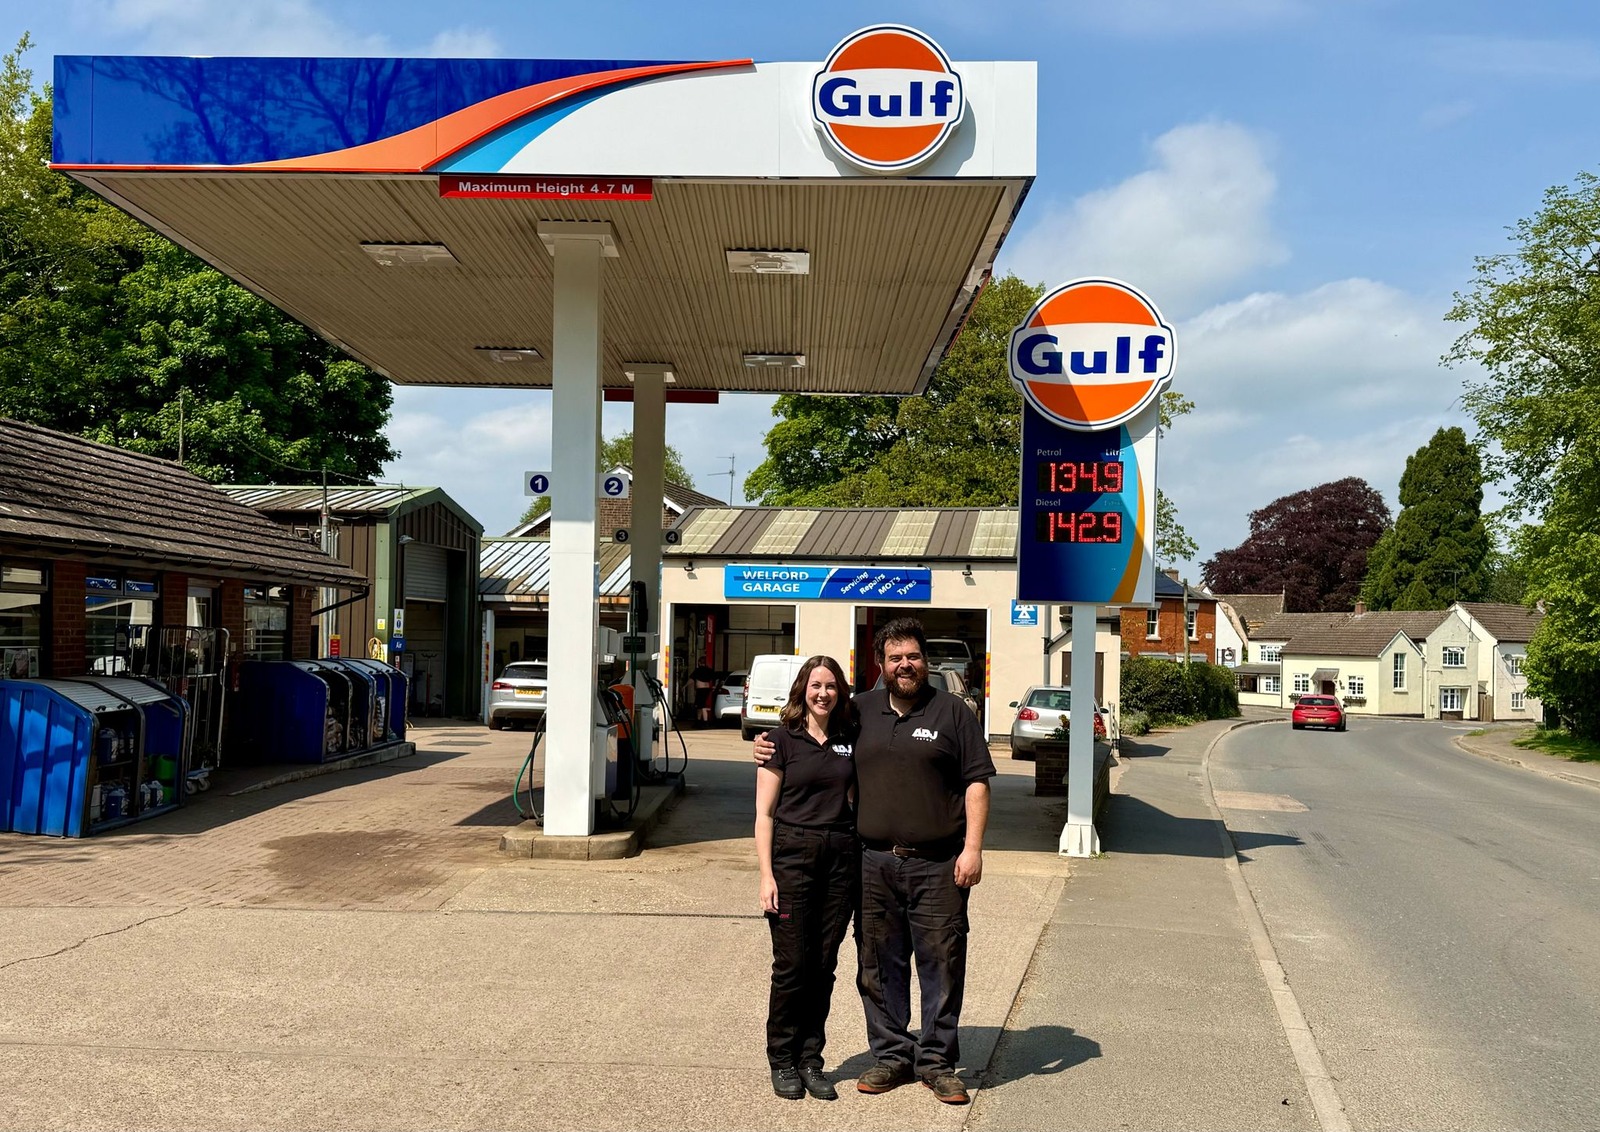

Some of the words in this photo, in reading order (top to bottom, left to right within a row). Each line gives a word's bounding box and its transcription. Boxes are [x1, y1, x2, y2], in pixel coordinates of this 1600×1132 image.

[819, 77, 954, 118] Gulf
[458, 181, 531, 193] Maximum
[536, 182, 585, 196] Height
[590, 184, 615, 194] 4.7
[621, 184, 635, 194] M
[1017, 333, 1166, 376] Gulf
[1037, 448, 1062, 457] Petrol
[1049, 462, 1122, 492] 134.9
[534, 478, 543, 491] 1
[608, 480, 619, 493] 2
[1035, 499, 1061, 507] Diesel
[1048, 512, 1121, 542] 142.9
[618, 530, 627, 541] 3
[667, 532, 676, 542] 4
[742, 570, 810, 581] WELFORD
[742, 582, 801, 593] GARAGE
[840, 571, 869, 595] Servicing
[859, 573, 886, 596] Repairs
[897, 579, 918, 597] Tyres
[395, 641, 403, 649] Air
[911, 727, 939, 740] ADJ
